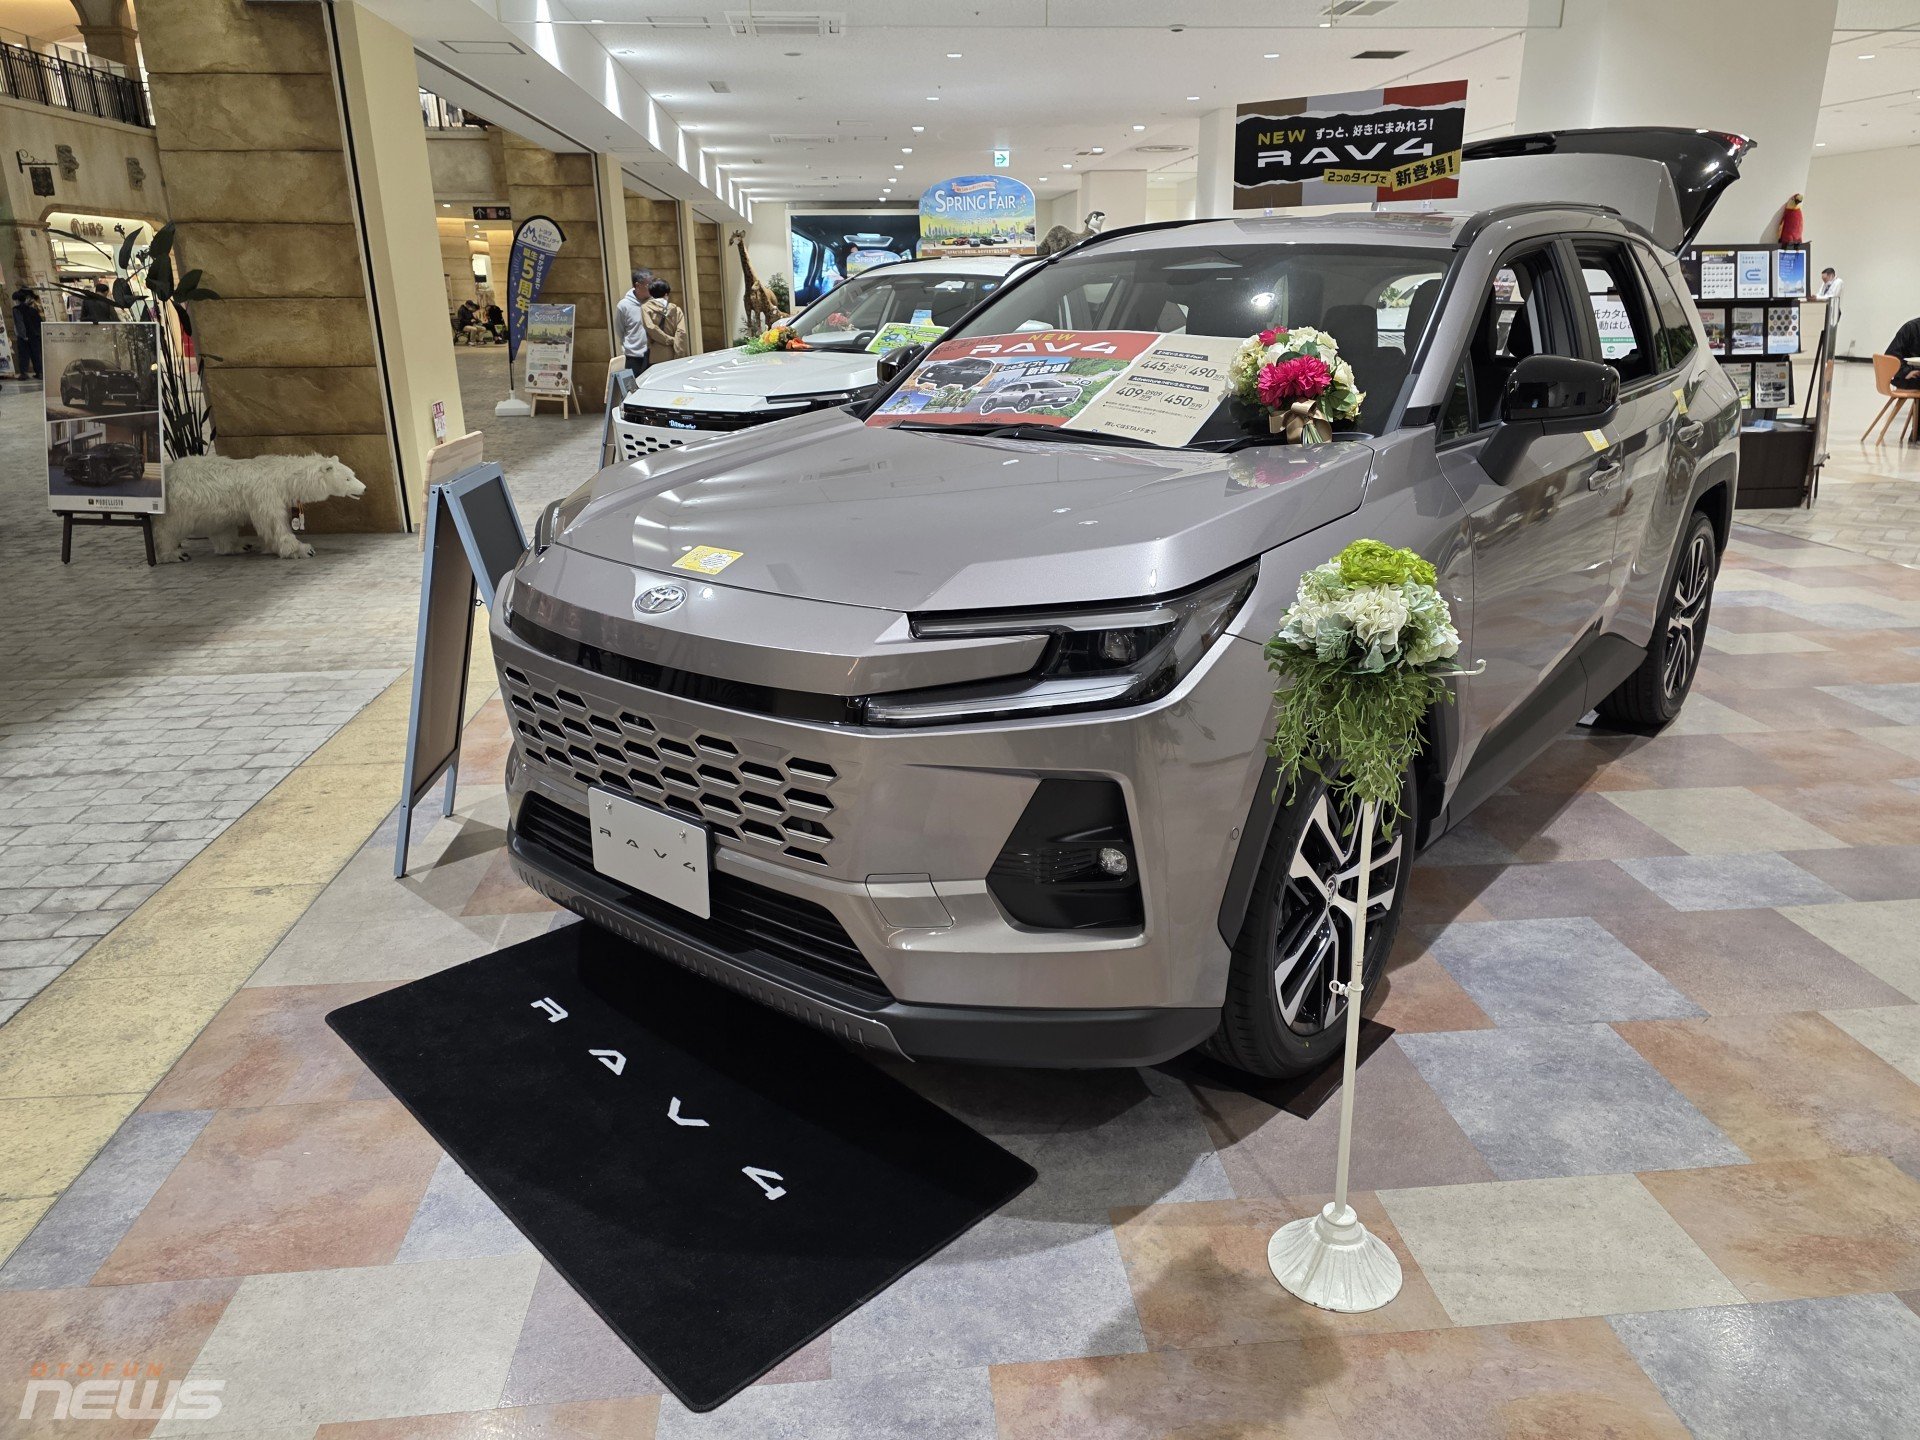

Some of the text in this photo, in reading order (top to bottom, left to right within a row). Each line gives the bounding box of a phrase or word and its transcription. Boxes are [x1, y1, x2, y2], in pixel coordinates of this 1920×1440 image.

[1257, 129, 1306, 146] NEW
[1257, 137, 1434, 168] RAV4
[1327, 171, 1387, 184] 2つのタイプで
[1396, 155, 1454, 187] 新登場!
[988, 190, 1016, 210] FAIR
[1029, 333, 1076, 341] NEW
[969, 341, 1118, 355] RAV4
[600, 826, 696, 873] RAV4
[530, 997, 787, 1201] RAV4
